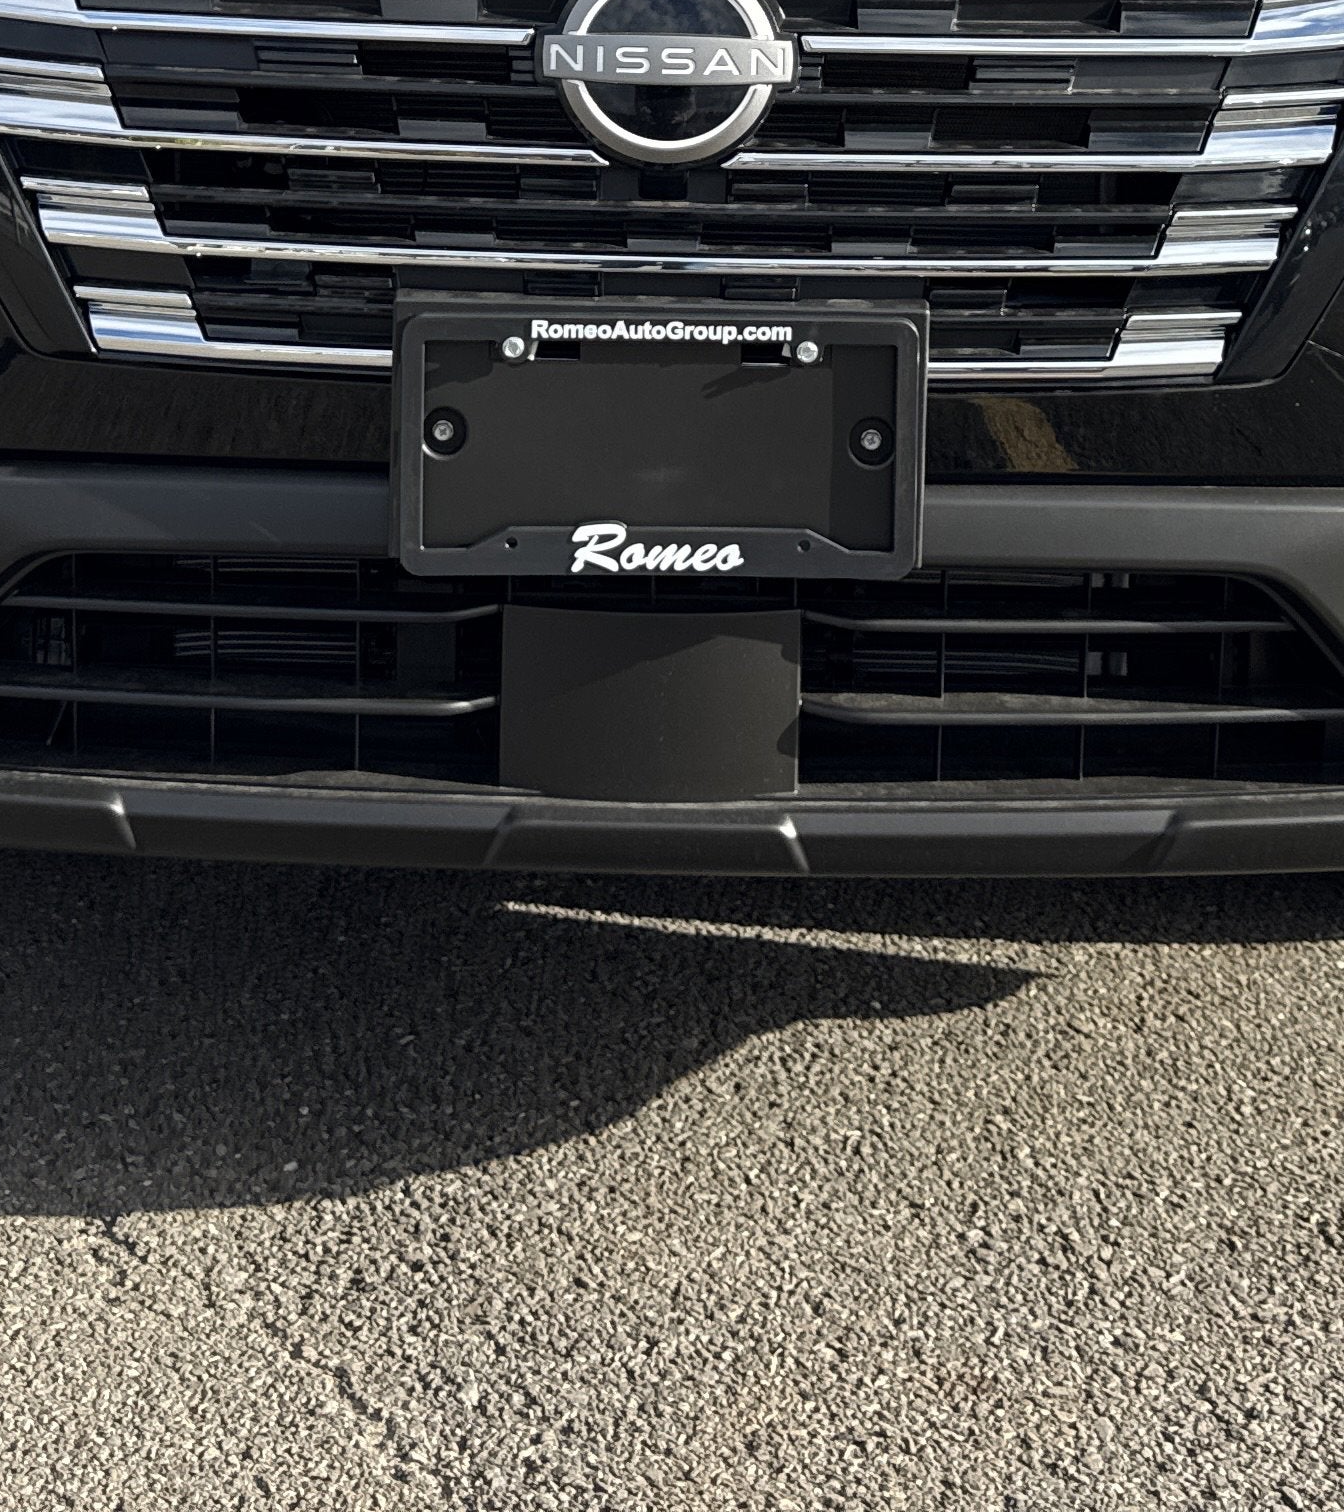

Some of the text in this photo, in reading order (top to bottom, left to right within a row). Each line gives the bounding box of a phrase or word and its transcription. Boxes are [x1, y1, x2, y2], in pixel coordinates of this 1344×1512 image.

[549, 43, 785, 77] NISSAN
[530, 319, 793, 344] RomeoAutoGroup.com
[570, 522, 745, 573] Romeo
